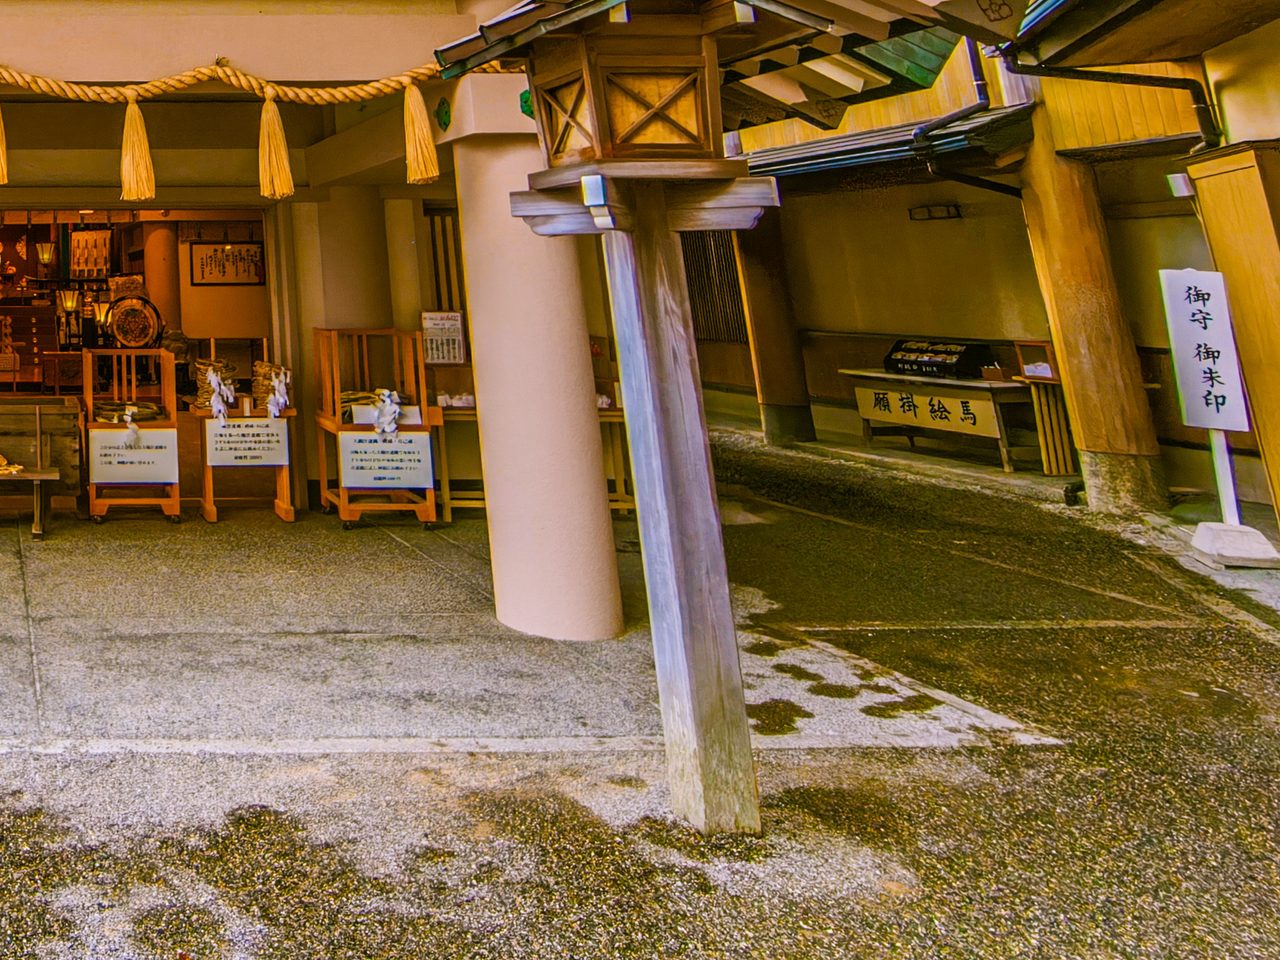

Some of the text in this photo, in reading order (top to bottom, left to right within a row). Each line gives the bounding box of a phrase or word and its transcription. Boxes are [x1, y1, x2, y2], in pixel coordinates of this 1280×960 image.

[1183, 285, 1227, 414] 御守 御朱印
[872, 391, 977, 426] 願掛絵馬
